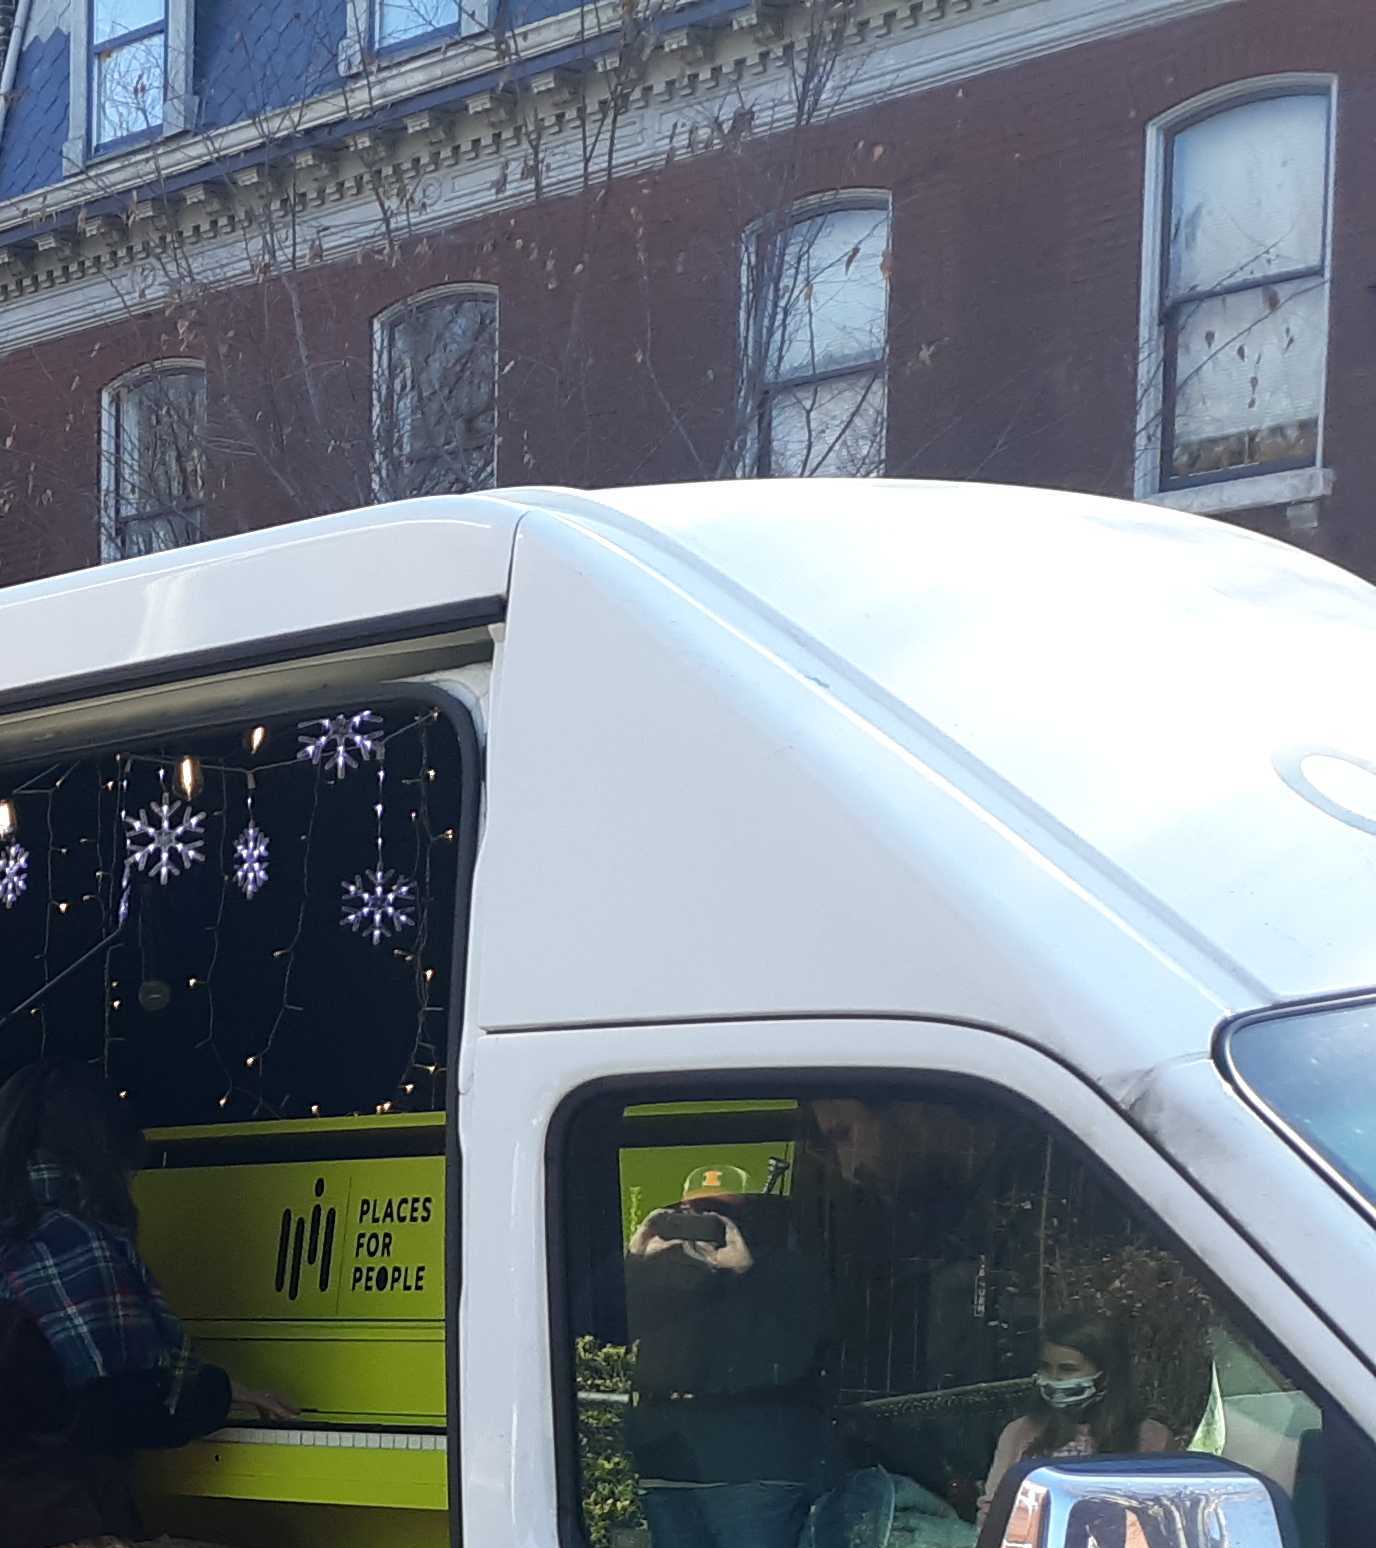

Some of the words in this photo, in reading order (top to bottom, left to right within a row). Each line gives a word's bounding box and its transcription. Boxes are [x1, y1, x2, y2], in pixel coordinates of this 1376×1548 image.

[358, 1197, 433, 1224] PLACES
[355, 1232, 393, 1258] FOR
[352, 1265, 426, 1292] PEOPLE
